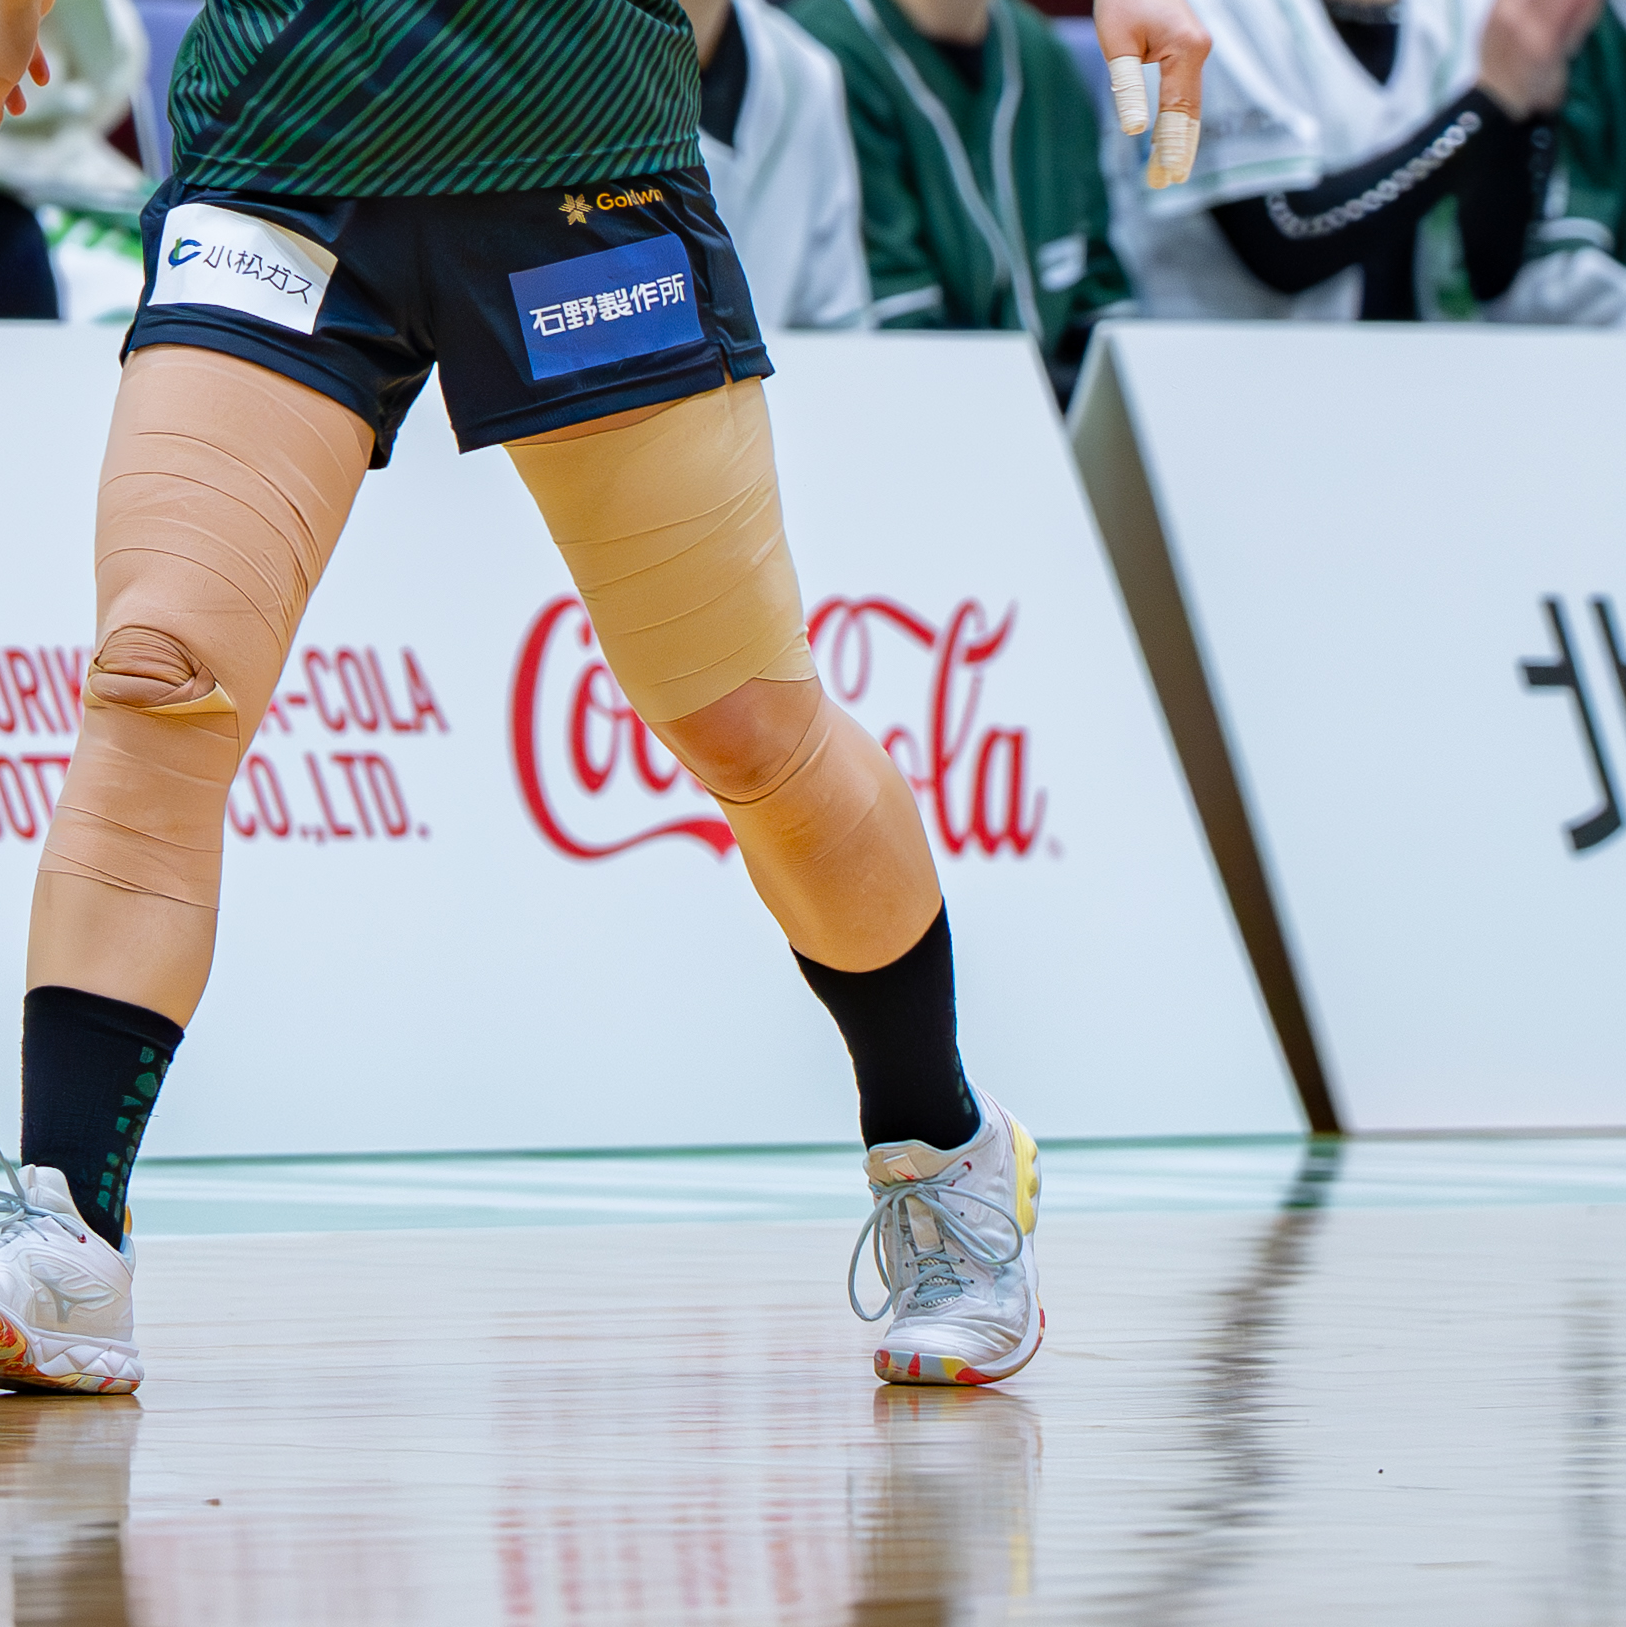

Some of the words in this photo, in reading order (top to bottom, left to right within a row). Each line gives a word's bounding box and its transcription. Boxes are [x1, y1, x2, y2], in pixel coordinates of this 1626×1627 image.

[203, 245, 313, 305] 小松ガス
[529, 273, 686, 337] 石野製作所
